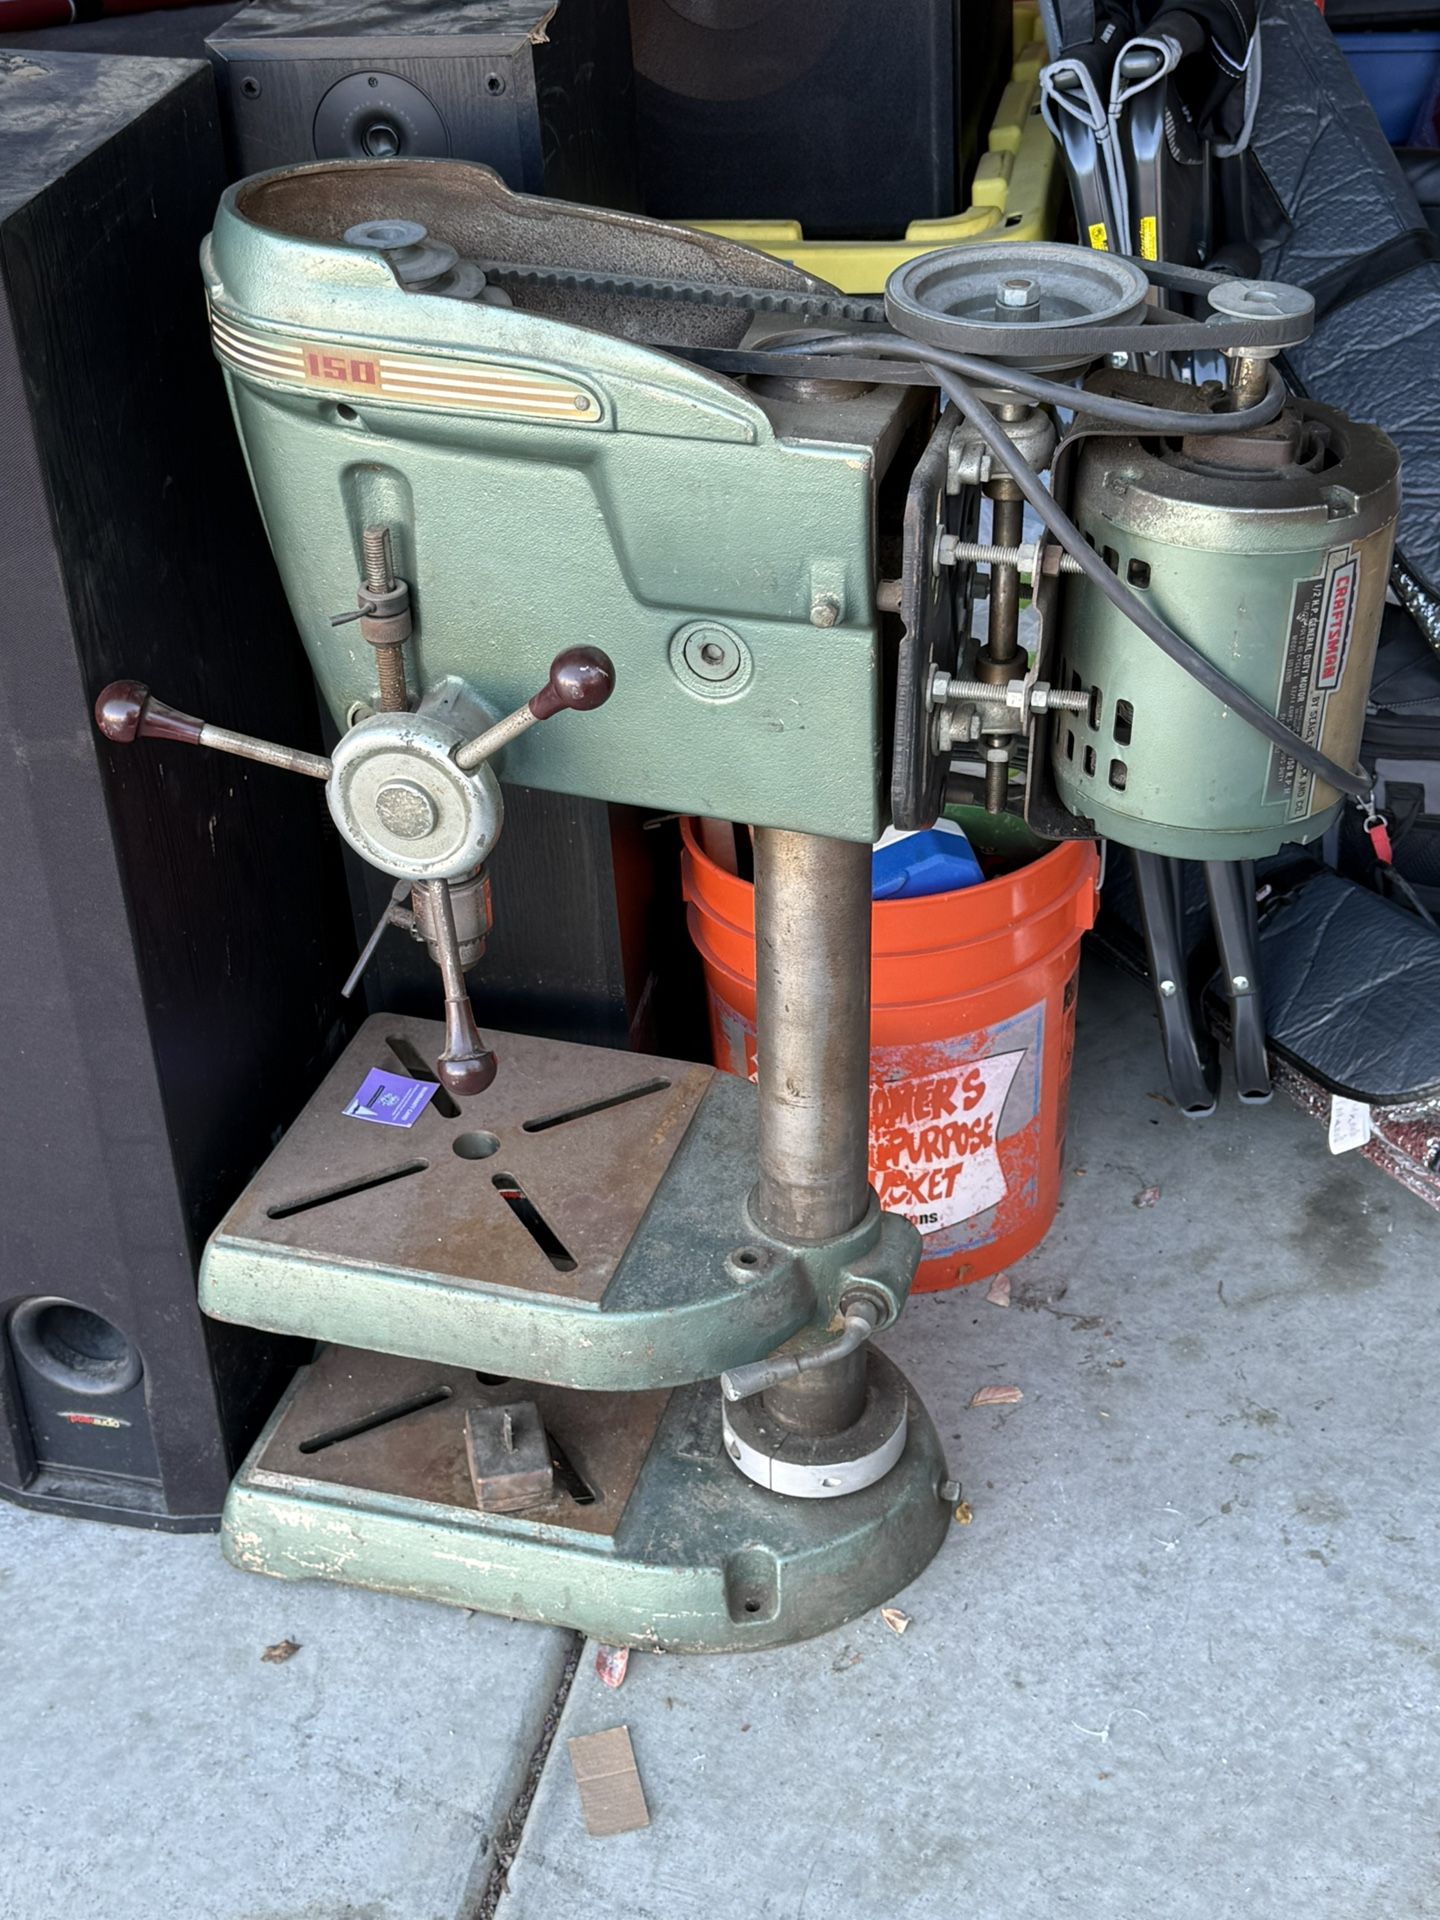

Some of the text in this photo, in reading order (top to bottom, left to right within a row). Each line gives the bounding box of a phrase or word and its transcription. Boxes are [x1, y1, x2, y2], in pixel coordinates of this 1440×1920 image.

[308, 353, 376, 385] 150
[1310, 583, 1323, 598] 1/2
[1303, 617, 1318, 652] GENERAL
[1321, 575, 1350, 680] CRAFTSMAN
[1299, 653, 1312, 673] DUTY
[1297, 674, 1309, 702] MOTOR
[1310, 695, 1321, 707] BY
[870, 1162, 963, 1205] UCKET
